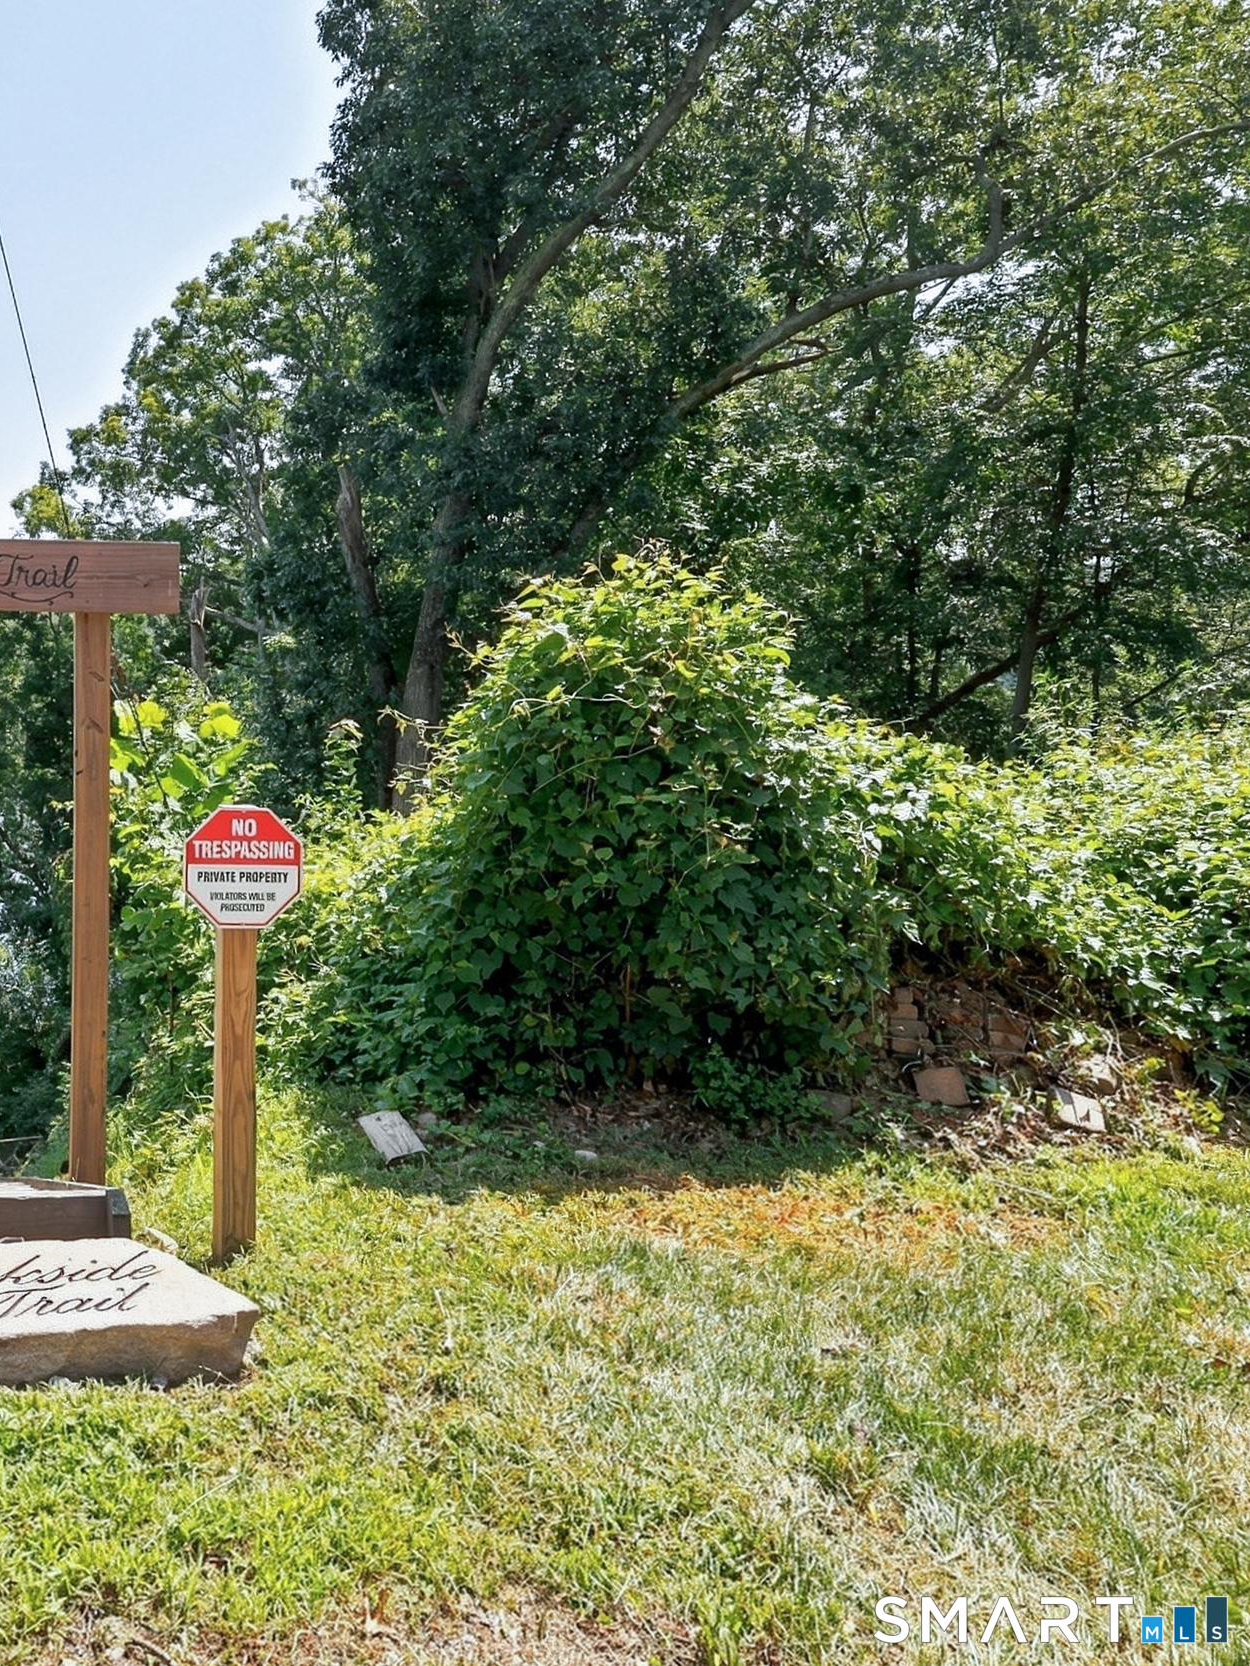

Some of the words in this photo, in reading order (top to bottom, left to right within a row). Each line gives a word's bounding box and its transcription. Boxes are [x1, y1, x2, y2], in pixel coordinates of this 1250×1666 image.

[231, 818, 257, 837] NO
[192, 840, 295, 859] TRESPASSING
[197, 871, 236, 883] PRIVATE
[239, 871, 289, 883] PROPERTY
[210, 892, 247, 901] VIOLATORS
[248, 892, 265, 901] WILL
[267, 892, 276, 901] BE
[220, 903, 265, 912] PROSECUTED
